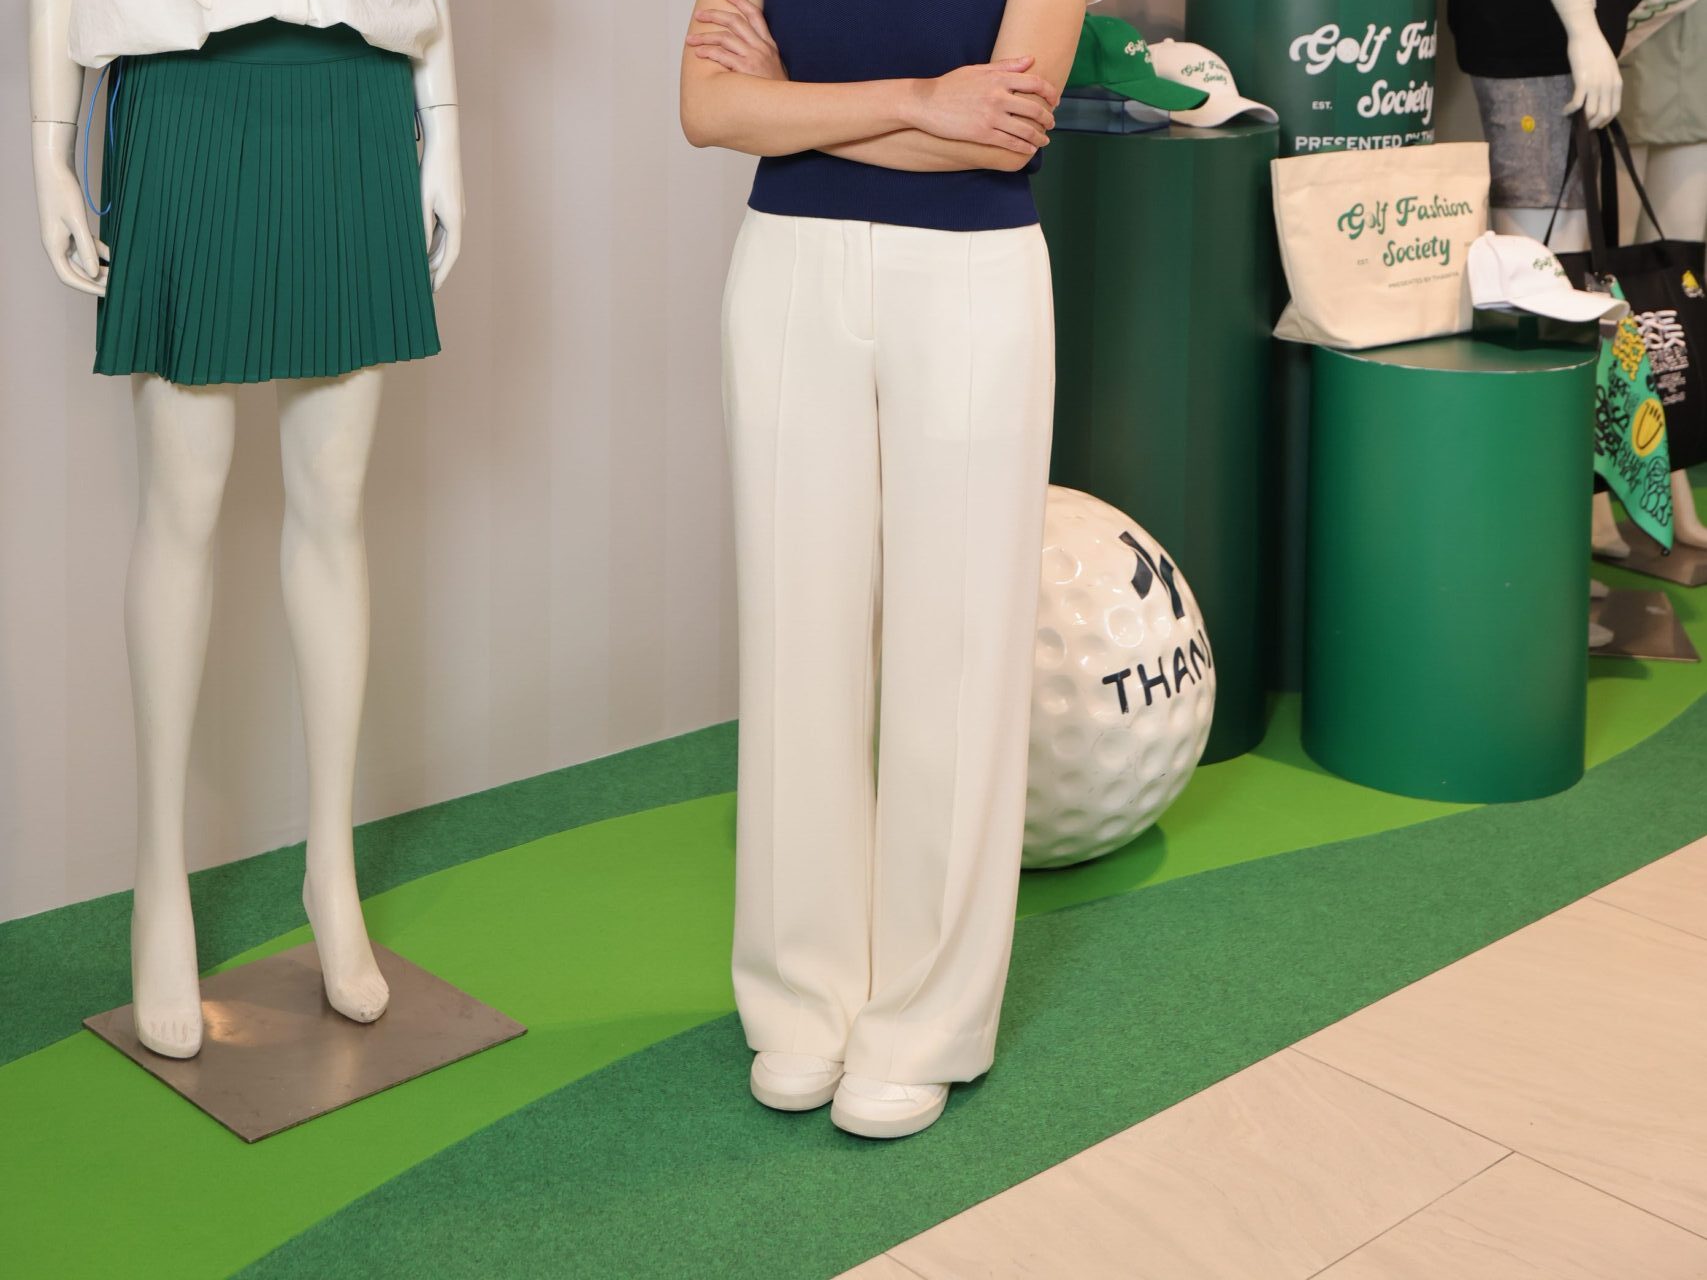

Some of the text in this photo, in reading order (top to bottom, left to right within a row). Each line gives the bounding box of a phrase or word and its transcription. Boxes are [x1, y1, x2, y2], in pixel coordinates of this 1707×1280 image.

[1289, 23, 1392, 76] Golf
[1312, 100, 1333, 111] EST.
[1357, 79, 1434, 126] Society
[1337, 194, 1473, 241] Golf Fashion
[1382, 235, 1451, 268] Society
